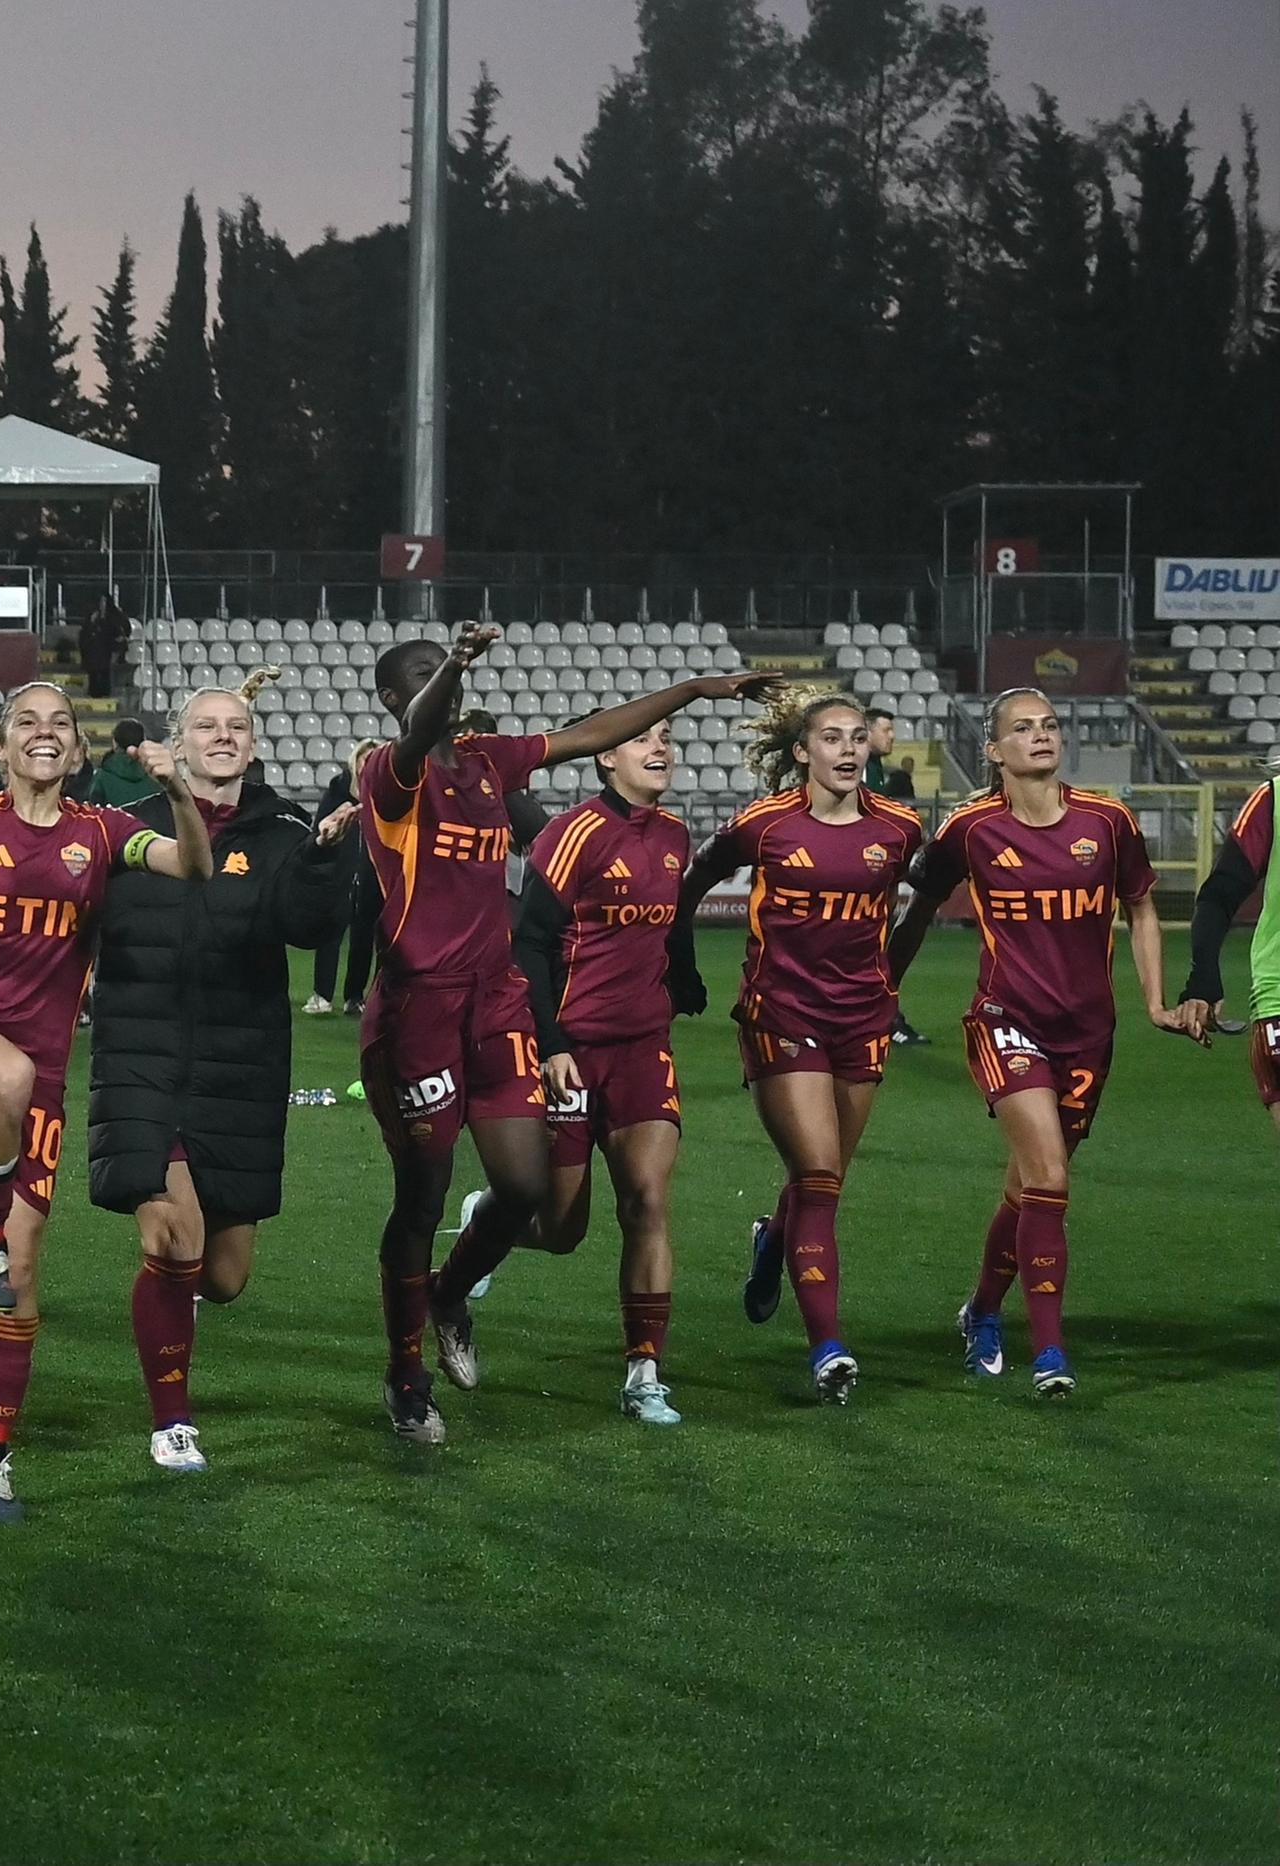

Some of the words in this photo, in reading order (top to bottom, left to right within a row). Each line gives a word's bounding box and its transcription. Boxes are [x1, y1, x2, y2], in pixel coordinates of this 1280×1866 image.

[404, 543, 423, 571] 7
[997, 547, 1016, 575] 8
[1165, 563, 1280, 593] DABLIU
[818, 891, 884, 920] TIM
[1033, 885, 1105, 920] TIM
[506, 1032, 541, 1079] 19
[1060, 1068, 1094, 1110] 2
[28, 1107, 63, 1170] 10
